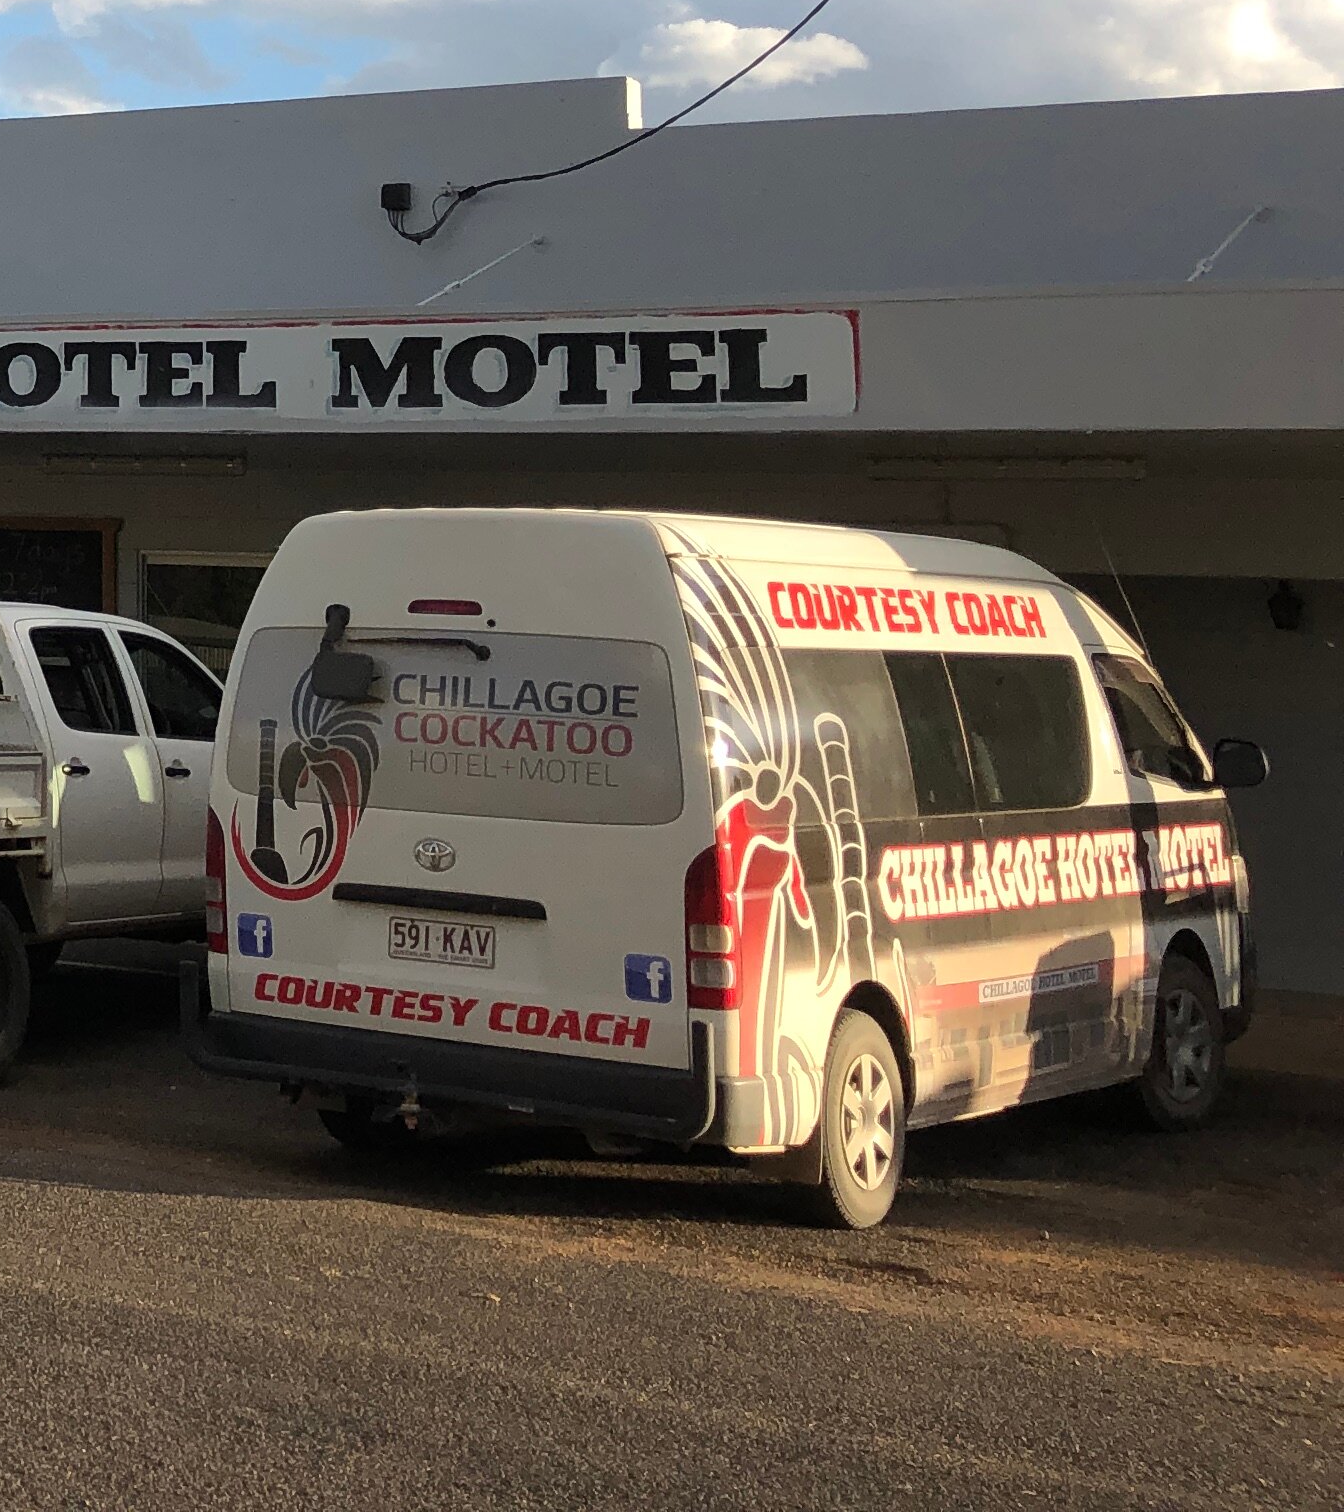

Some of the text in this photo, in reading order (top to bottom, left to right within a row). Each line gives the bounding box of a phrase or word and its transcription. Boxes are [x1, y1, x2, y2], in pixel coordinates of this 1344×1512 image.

[330, 328, 809, 408] MOTEL
[766, 581, 1048, 639] COURTESY COACH
[392, 673, 640, 719] CHILLAGOE
[394, 711, 634, 757] COCKATOO
[876, 823, 1232, 922] CHILLAGOE HOTEL MOTEL
[1038, 972, 1065, 990] HOTEL
[254, 972, 652, 1050] COURTESY COACH
